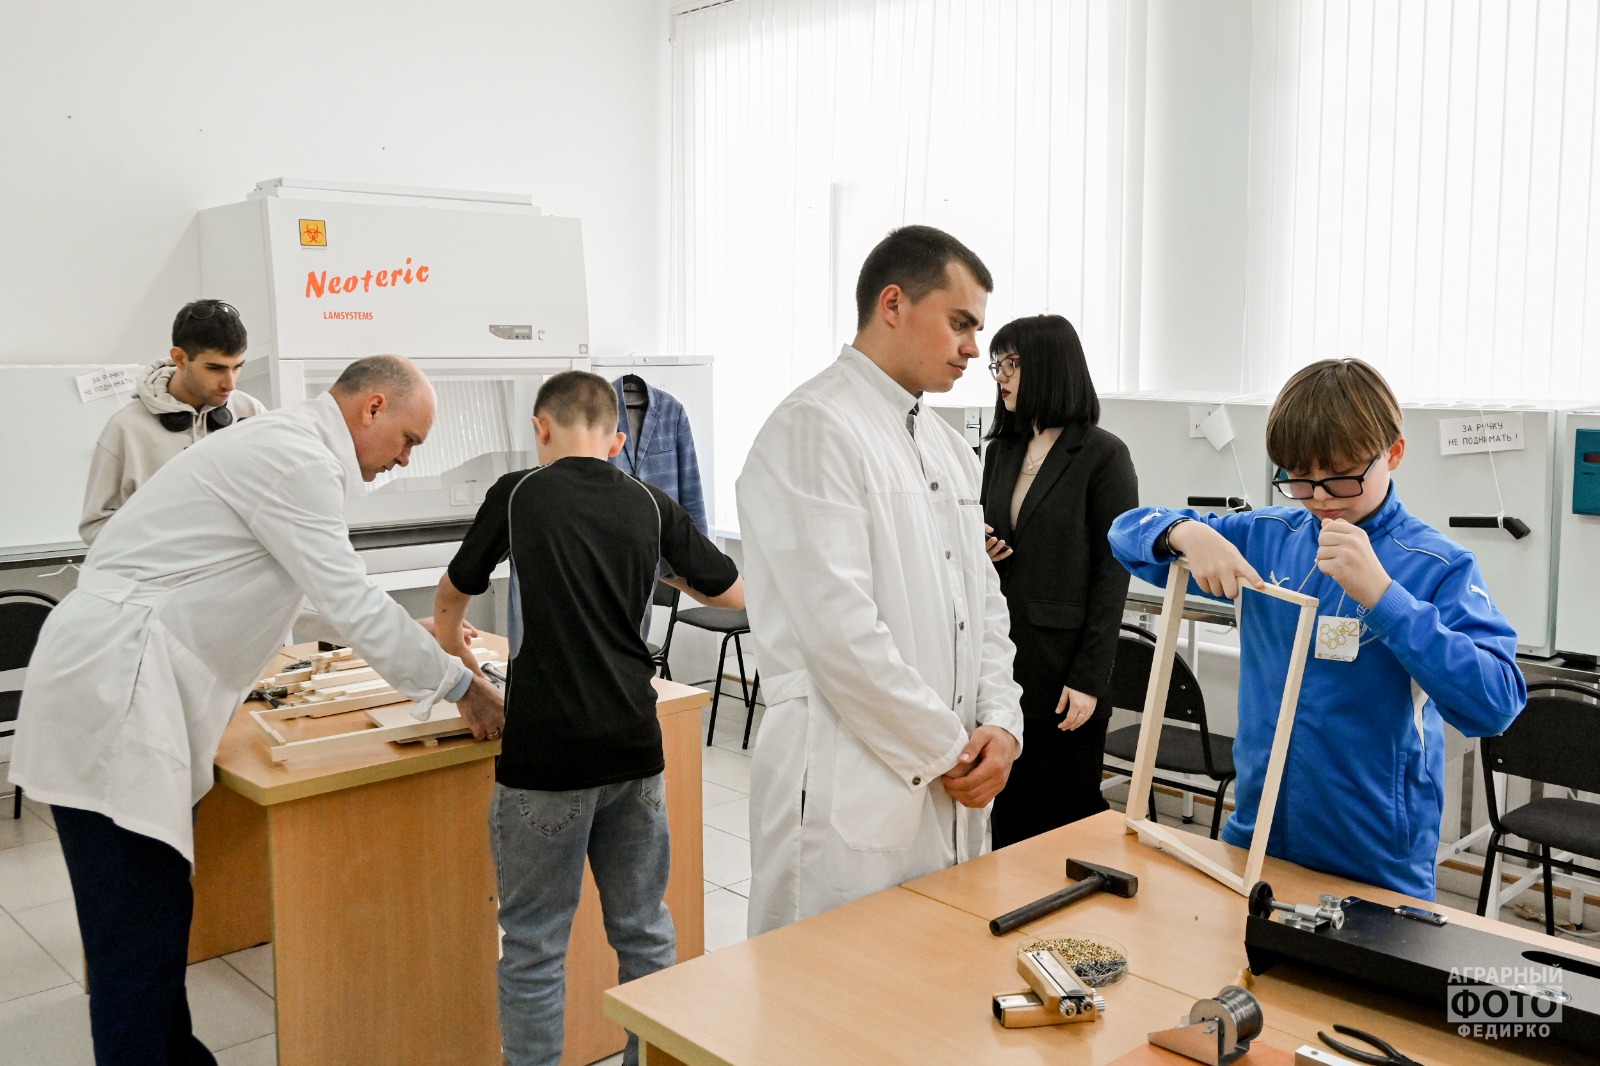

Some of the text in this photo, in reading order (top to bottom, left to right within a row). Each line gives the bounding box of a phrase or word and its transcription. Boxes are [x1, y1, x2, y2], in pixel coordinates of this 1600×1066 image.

[305, 257, 430, 299] Neoteric
[323, 311, 374, 321] LAMSYSTEMS
[1462, 424, 1473, 433] ЗА
[1448, 437, 1459, 446] НЕ
